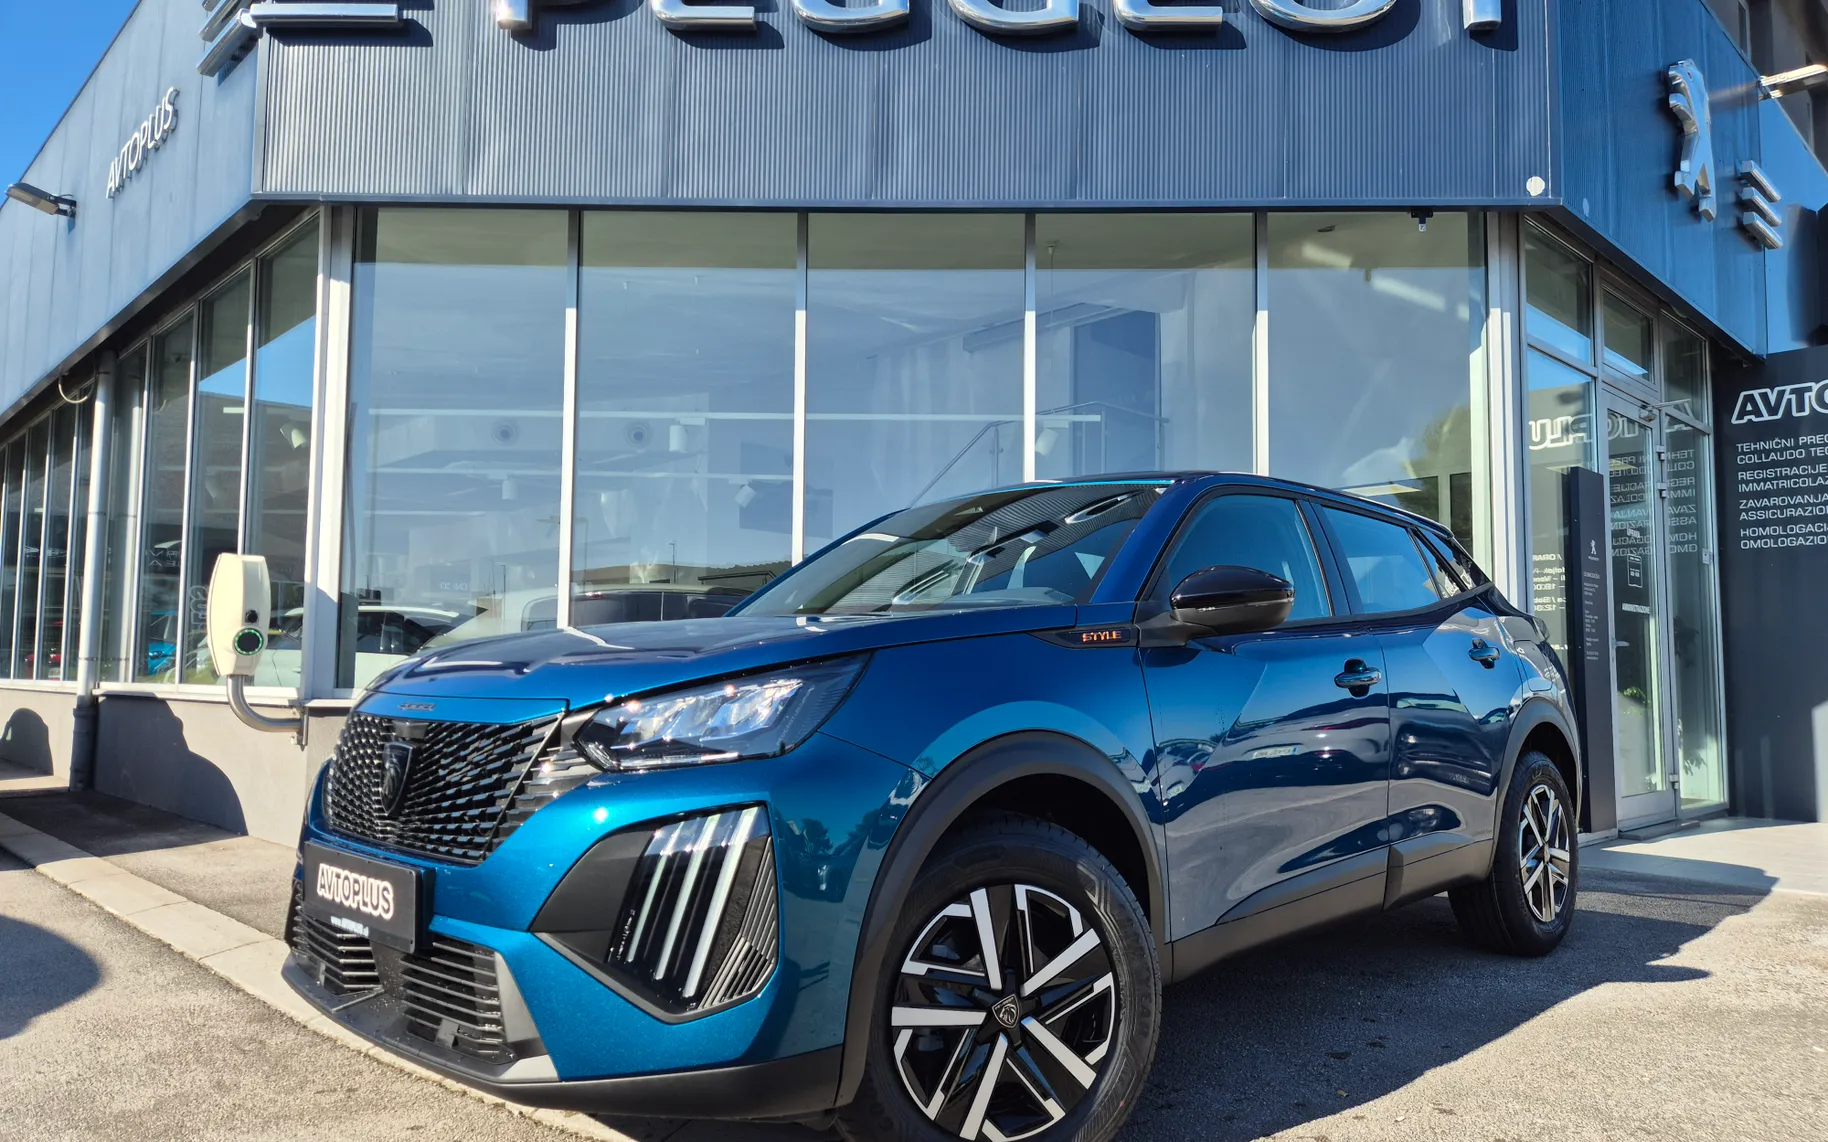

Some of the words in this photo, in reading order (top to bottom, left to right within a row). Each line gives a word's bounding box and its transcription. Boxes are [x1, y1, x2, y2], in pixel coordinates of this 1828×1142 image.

[106, 86, 179, 199] AVTOPLUS
[1736, 437, 1794, 453] TEHNIČNI
[1737, 448, 1805, 465] COLLAUDO
[1738, 463, 1828, 481] REGISTRACIJE
[1739, 493, 1828, 509] ZAVAROVANJA
[1740, 505, 1828, 521] ASSICURAZIO
[1740, 522, 1828, 538] HOMOLOGACI
[1741, 535, 1828, 550] OMOLOGAZIO
[1082, 630, 1122, 643] STYLE
[317, 863, 395, 921] AVTOPLUS
